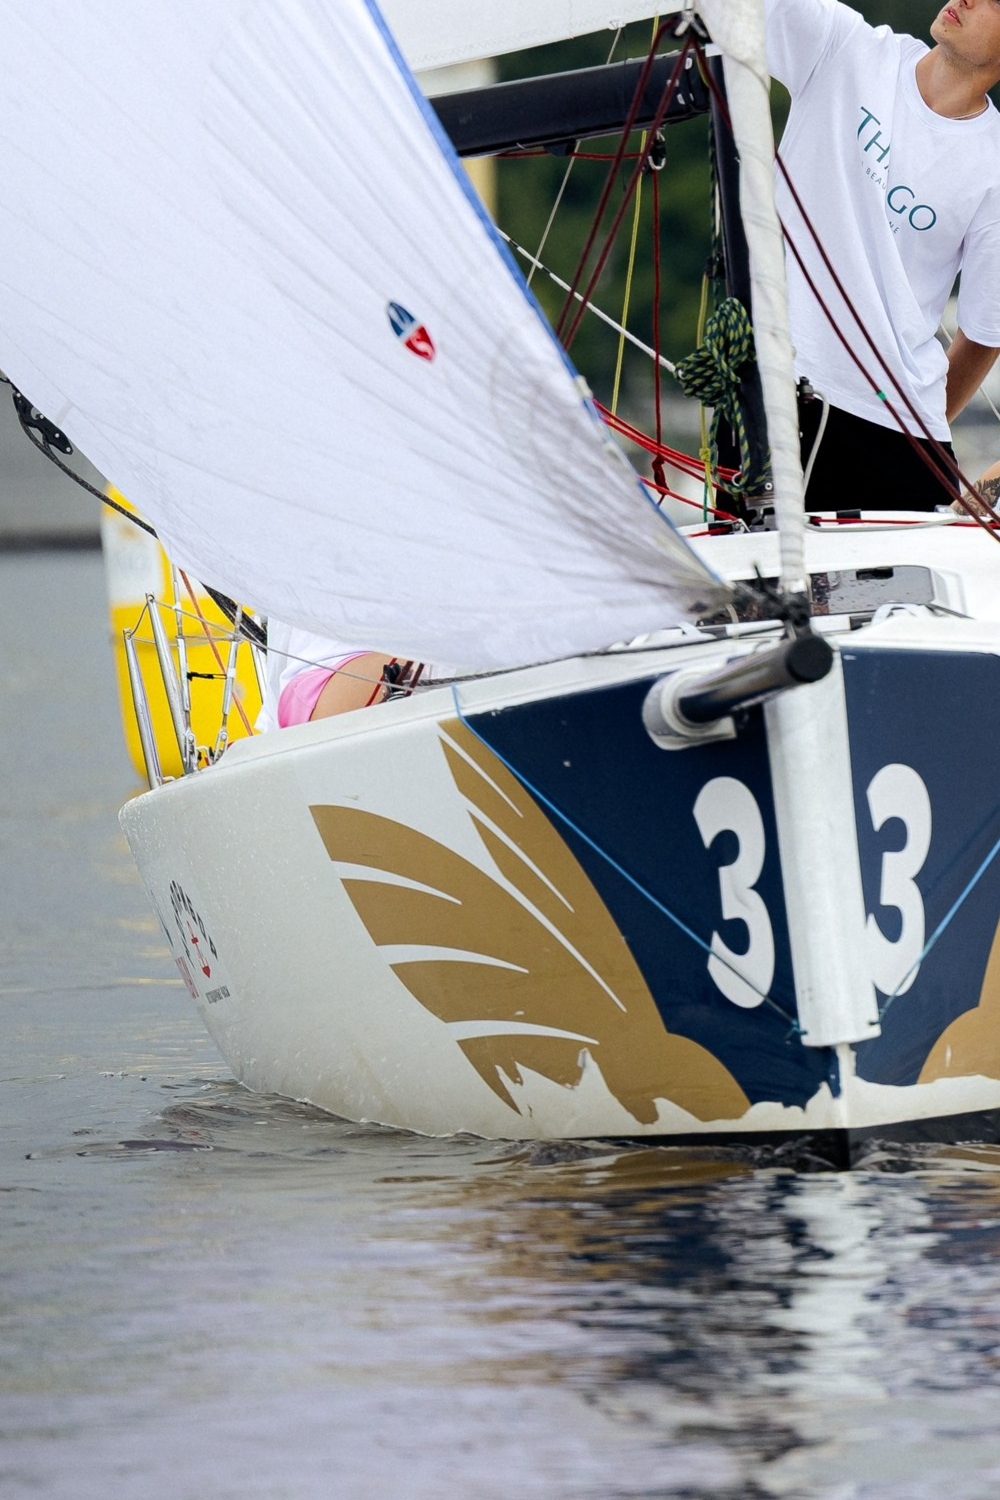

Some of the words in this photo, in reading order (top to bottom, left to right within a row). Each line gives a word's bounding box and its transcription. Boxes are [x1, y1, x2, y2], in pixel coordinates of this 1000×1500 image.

[857, 106, 937, 231] THGO
[692, 776, 775, 1009] 3
[866, 763, 932, 997] 3
